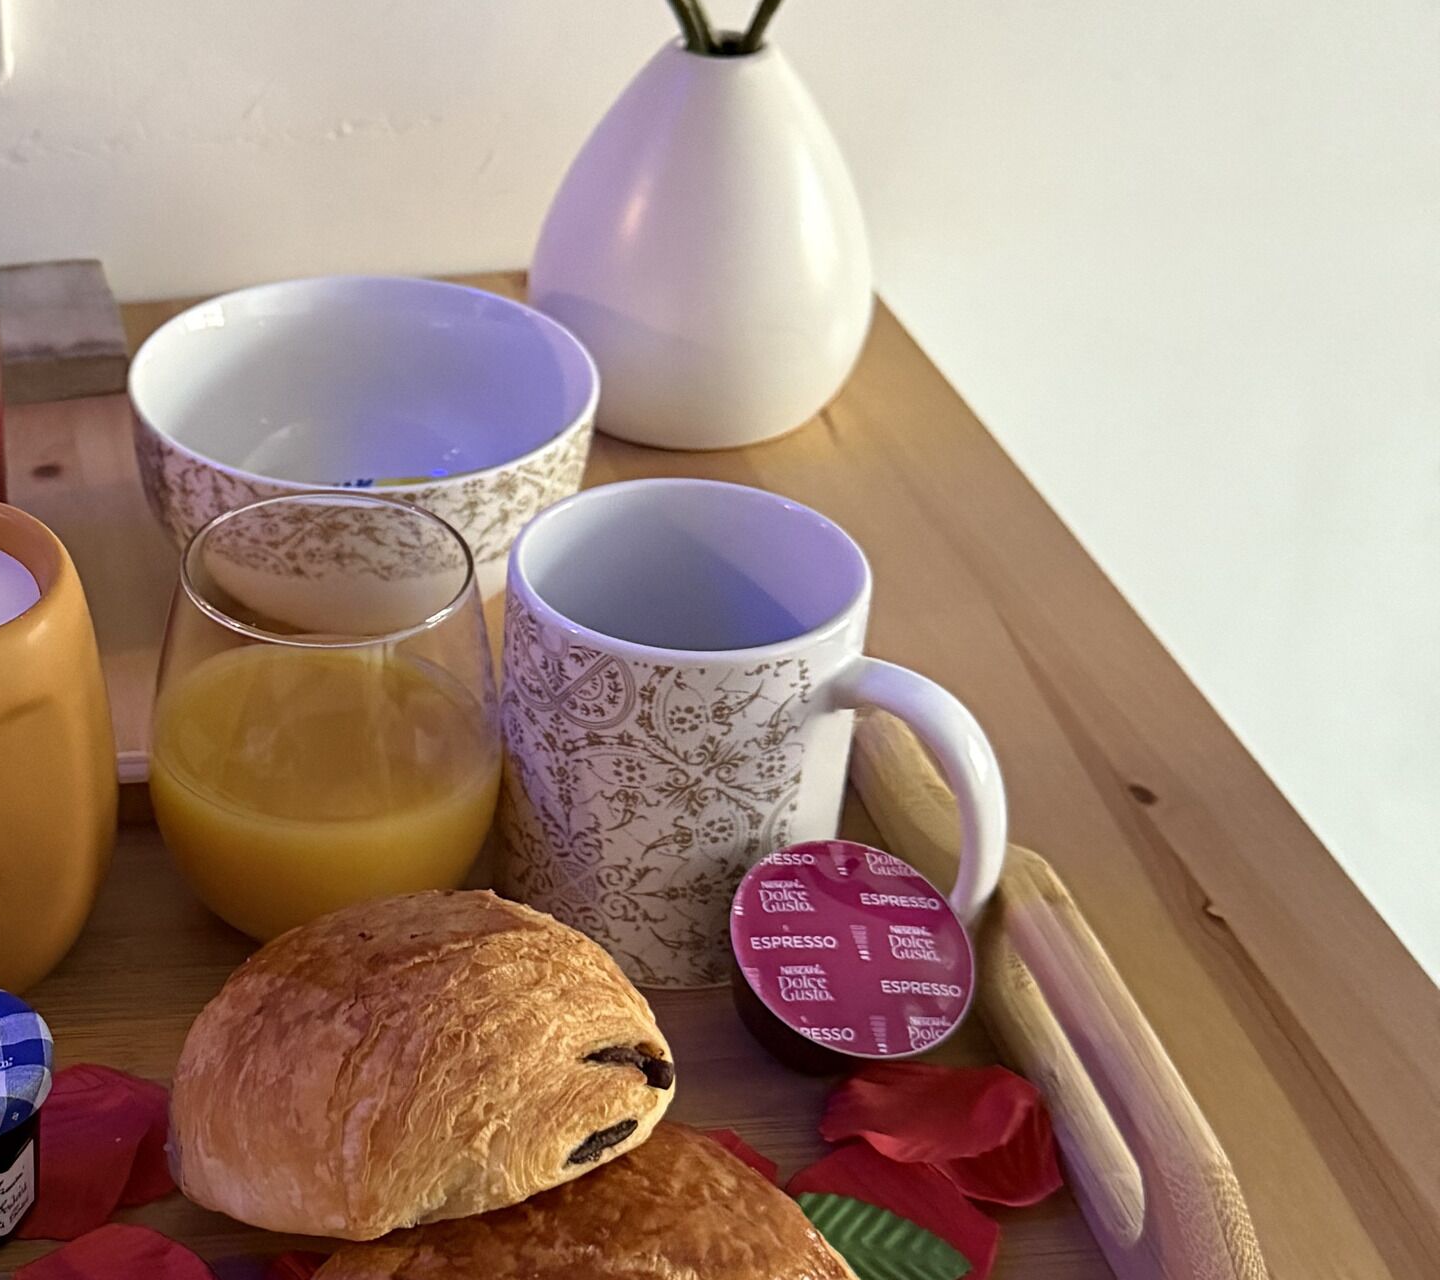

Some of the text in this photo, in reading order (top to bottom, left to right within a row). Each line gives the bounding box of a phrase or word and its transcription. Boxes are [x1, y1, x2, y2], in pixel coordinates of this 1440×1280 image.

[758, 888, 809, 902] Dolce
[859, 892, 941, 910] ESPRESSO
[761, 899, 813, 913] Gusto
[750, 935, 837, 950] ESPRESSO
[887, 934, 936, 949] Dolce
[891, 946, 939, 961] Gusto
[777, 975, 828, 990] Dolce
[880, 980, 962, 998] ESPRESSO
[780, 987, 832, 1002] Gusto
